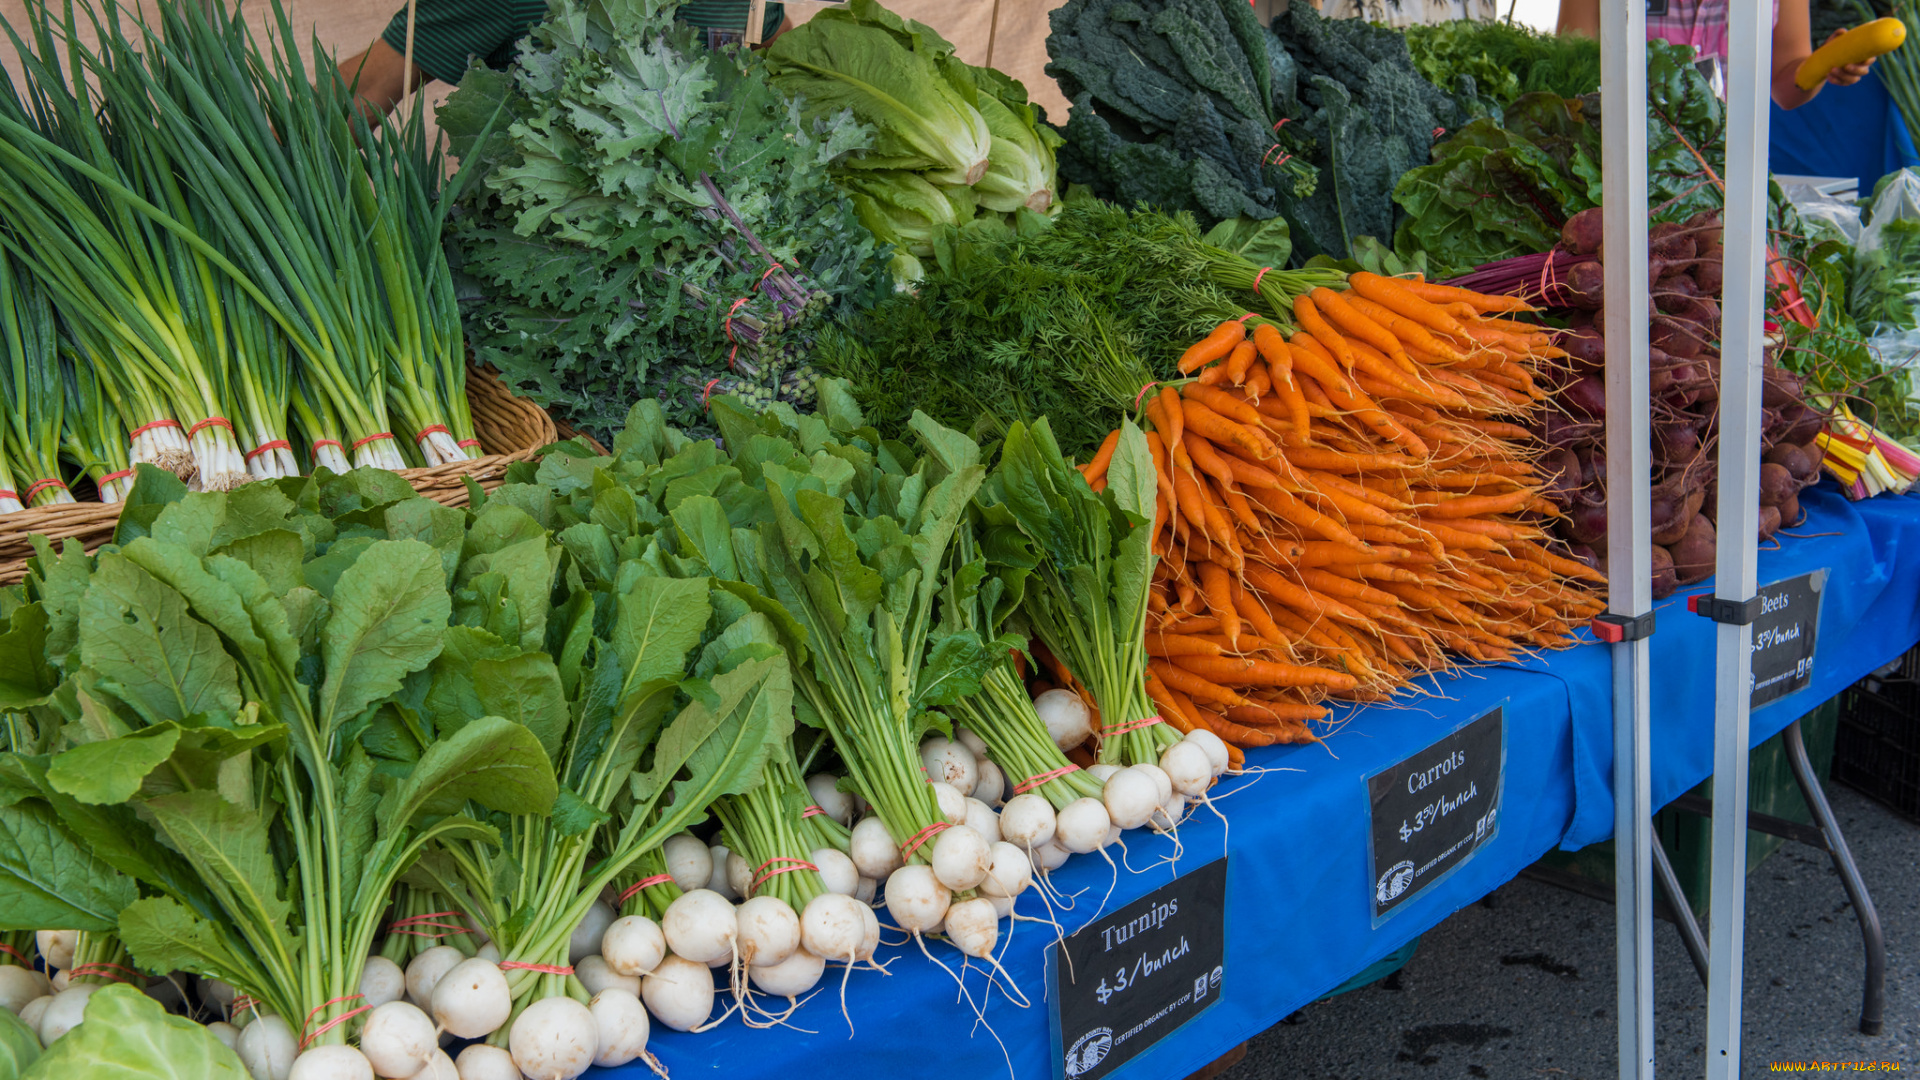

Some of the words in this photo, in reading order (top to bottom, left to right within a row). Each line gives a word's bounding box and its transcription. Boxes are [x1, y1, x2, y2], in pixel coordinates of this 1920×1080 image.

[1760, 592, 1789, 615] Beets
[1407, 749, 1465, 794] Carrots
[1415, 857, 1437, 878] CERTIFIED
[1437, 844, 1457, 862] ORGANIC
[1101, 897, 1179, 952] Turnips
[1095, 935, 1190, 1005] $3/bunch
[1114, 1022, 1144, 1046] CERTIFIED
[1143, 1006, 1169, 1028] ORGANIC
[1169, 1001, 1177, 1012] BY
[1177, 991, 1192, 1006] CCOF
